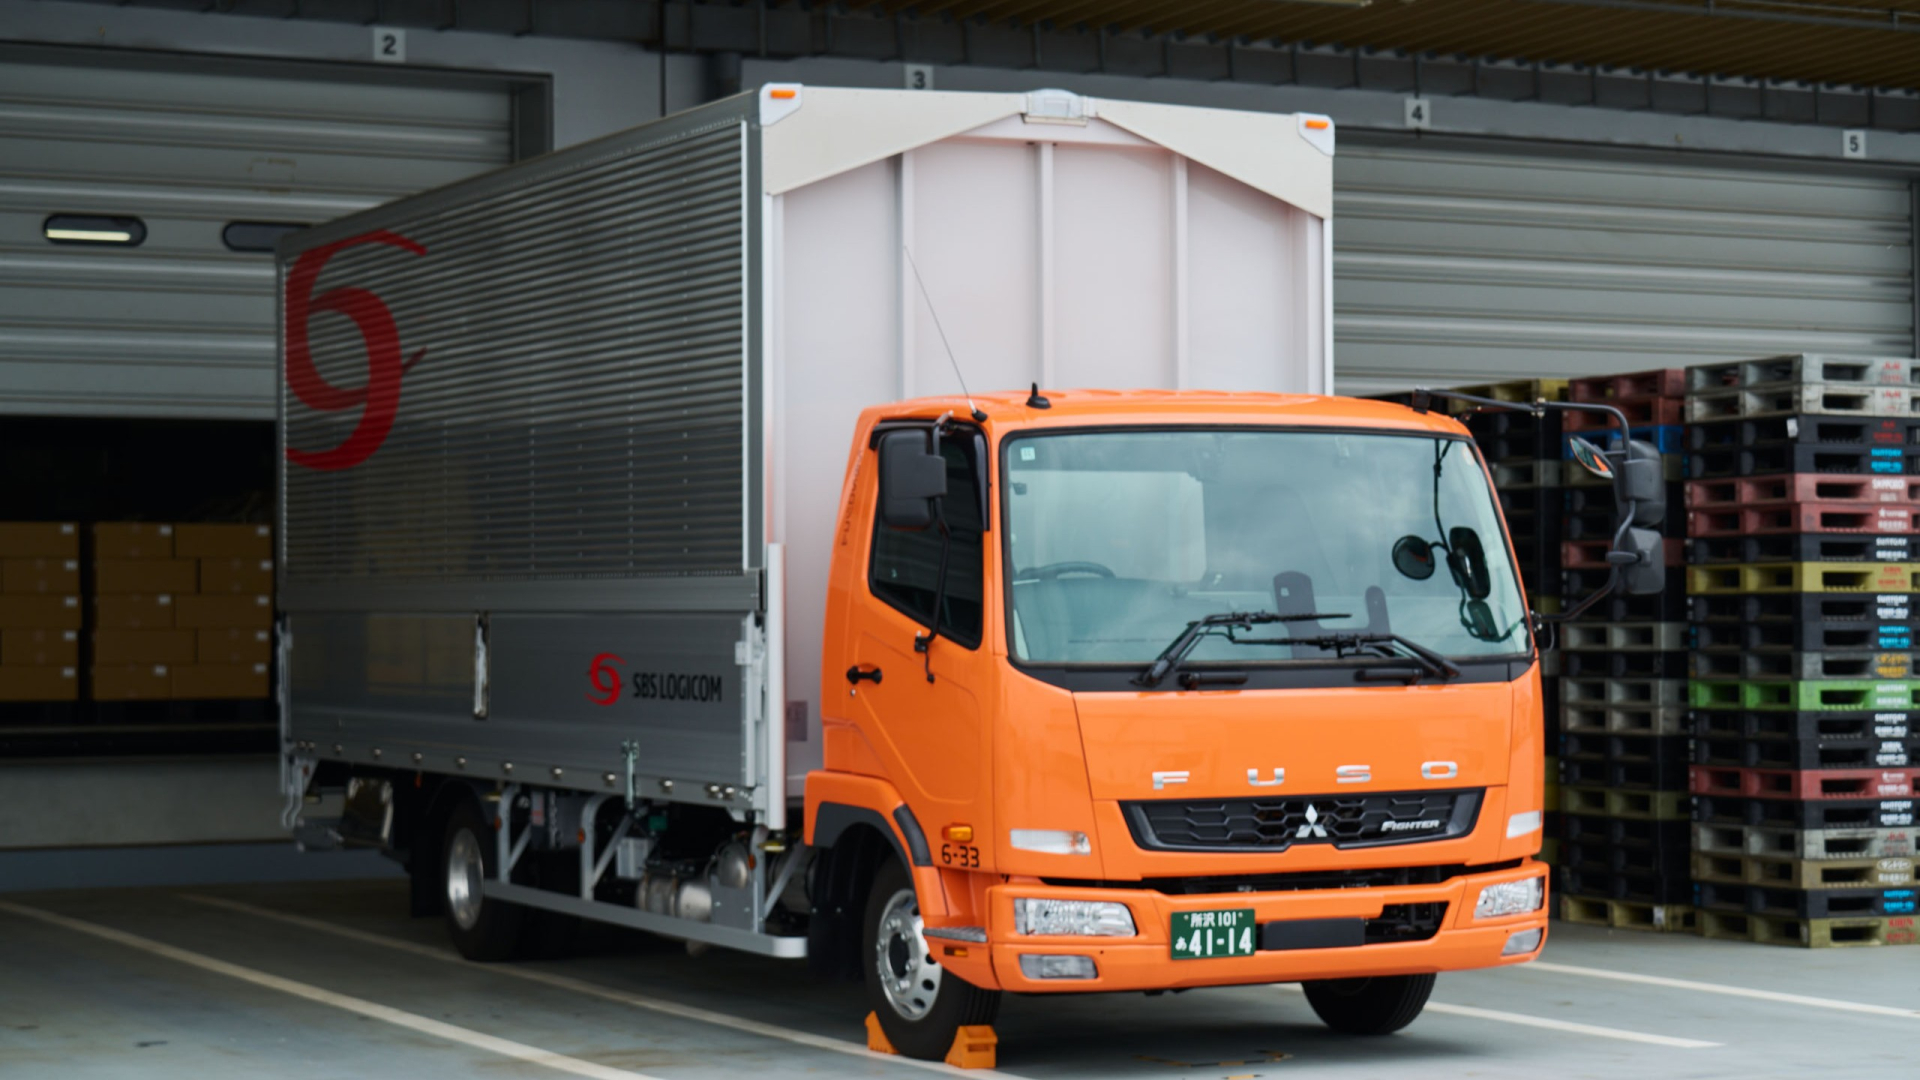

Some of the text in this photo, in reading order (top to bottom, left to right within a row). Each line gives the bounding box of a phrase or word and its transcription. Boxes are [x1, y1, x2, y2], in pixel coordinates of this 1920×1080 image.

[382, 34, 397, 56] 2
[913, 70, 926, 90] 3
[1411, 105, 1423, 122] 4
[1850, 135, 1858, 153] 5
[633, 672, 723, 702] SBS LOGICOM
[1152, 761, 1458, 790] FUSO
[1190, 911, 1237, 928] 所沢 101
[1188, 926, 1252, 957] 41-14
